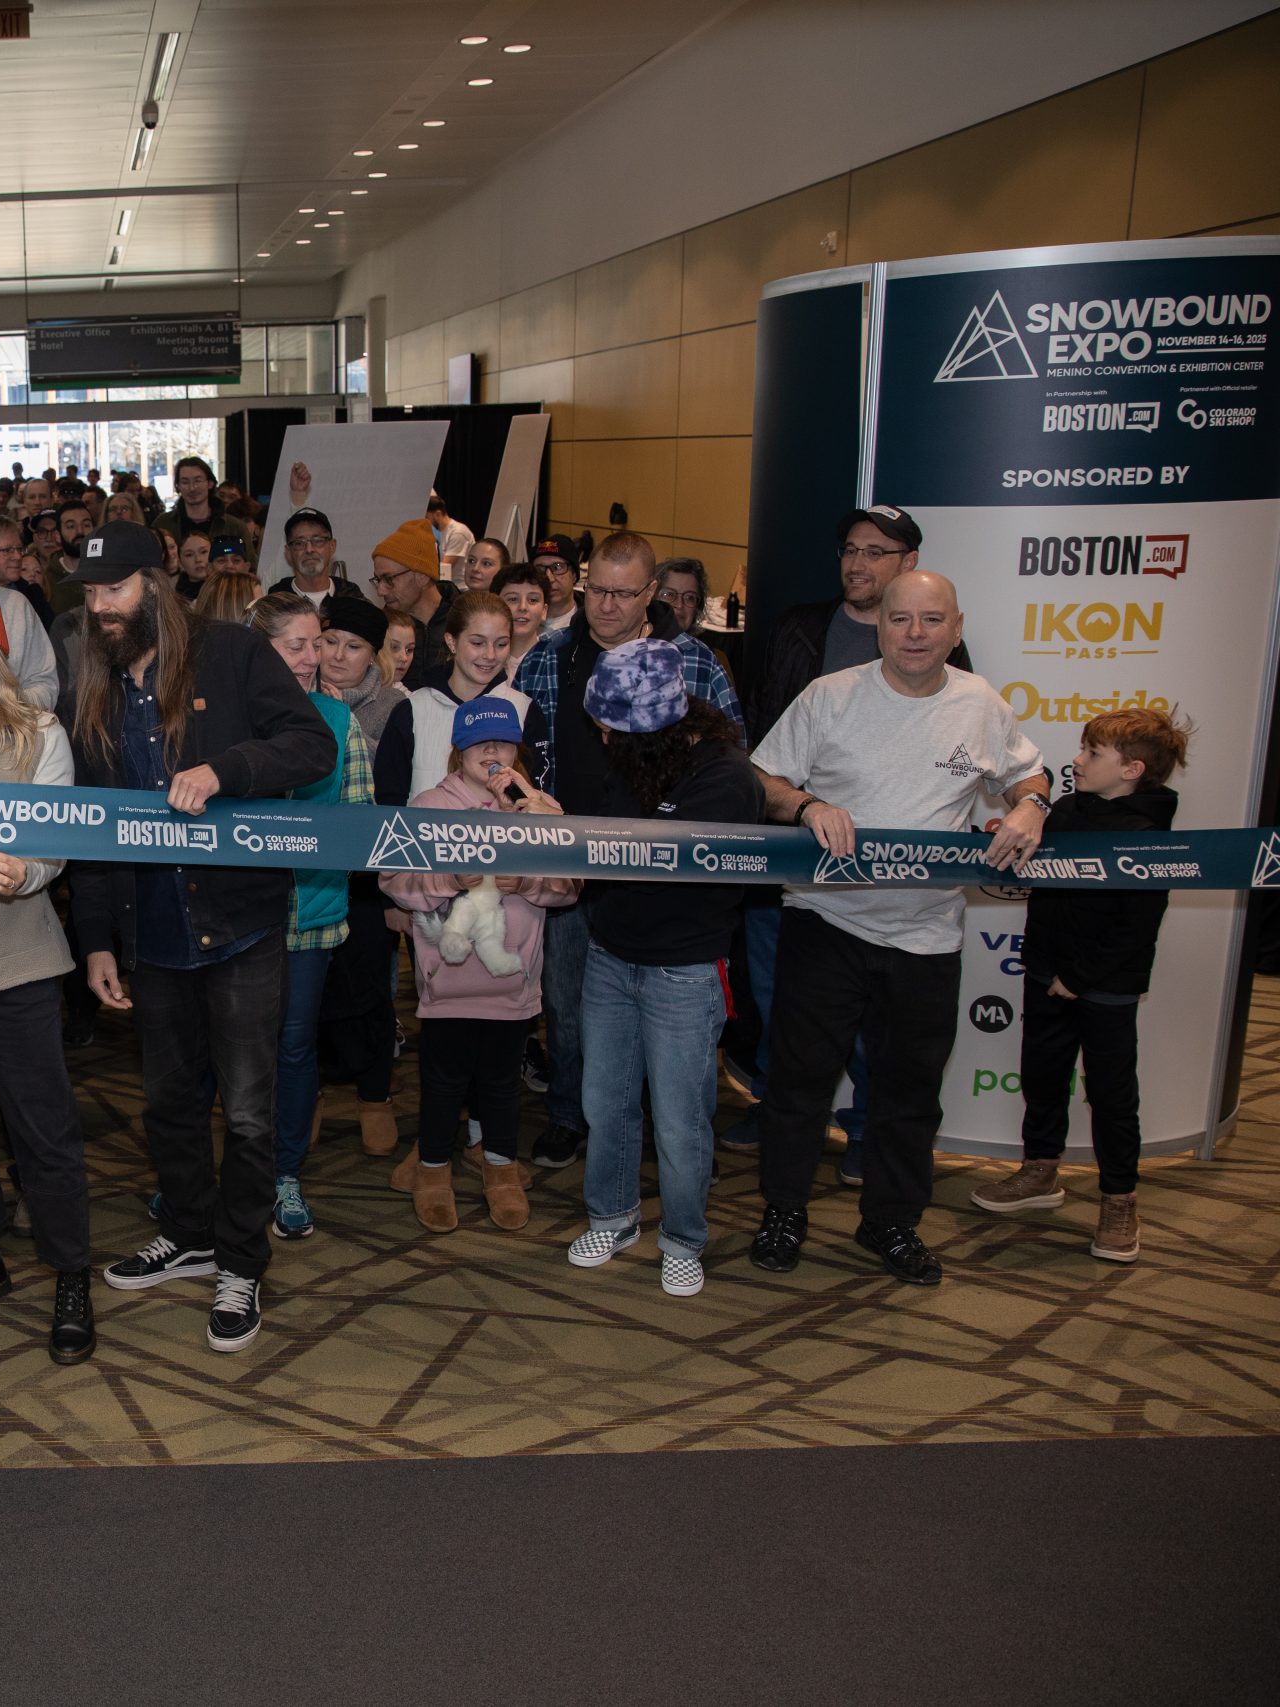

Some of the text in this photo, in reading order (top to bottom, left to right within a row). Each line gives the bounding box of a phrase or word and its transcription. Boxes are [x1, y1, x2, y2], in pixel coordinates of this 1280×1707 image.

[1025, 294, 1271, 333] SNOWBOUND
[40, 328, 111, 339] Executive Office
[130, 326, 177, 336] Exhibition
[180, 324, 203, 334] Halls
[40, 341, 64, 350] Hotel
[156, 335, 229, 347] Meeting Rooms
[1157, 334, 1267, 347] NOVEMBER 14-16, 2025
[211, 345, 229, 354] East
[1047, 330, 1152, 364] EXPO
[1047, 361, 1264, 378] MENINO CONVENTION & EXHIBITION CENTER
[1053, 390, 1092, 399] Partnership
[1209, 408, 1256, 418] COLORADO
[1209, 417, 1224, 427] SKI
[1226, 416, 1251, 426] SHOP
[1002, 465, 1190, 488] SPONSORED BY
[1023, 602, 1164, 643] IKON
[1065, 647, 1118, 659] PASS
[475, 711, 508, 721] ATTITASH
[935, 762, 984, 774] SNOWBOUND
[951, 769, 968, 777] EXPO
[265, 835, 318, 844] COLORADO
[418, 822, 575, 846] SNOWBOUND
[267, 843, 284, 851] SKI
[286, 843, 314, 852] SHOP
[435, 842, 497, 864] EXPO
[860, 841, 989, 864] SNOWBOUN
[721, 853, 768, 864] COLORADO
[721, 861, 736, 870] SKI
[738, 863, 764, 872] SHOP
[871, 862, 929, 880] EXPO
[1148, 863, 1199, 871] COLORADO
[1152, 870, 1169, 878] SKI
[1169, 869, 1197, 878] SHOP
